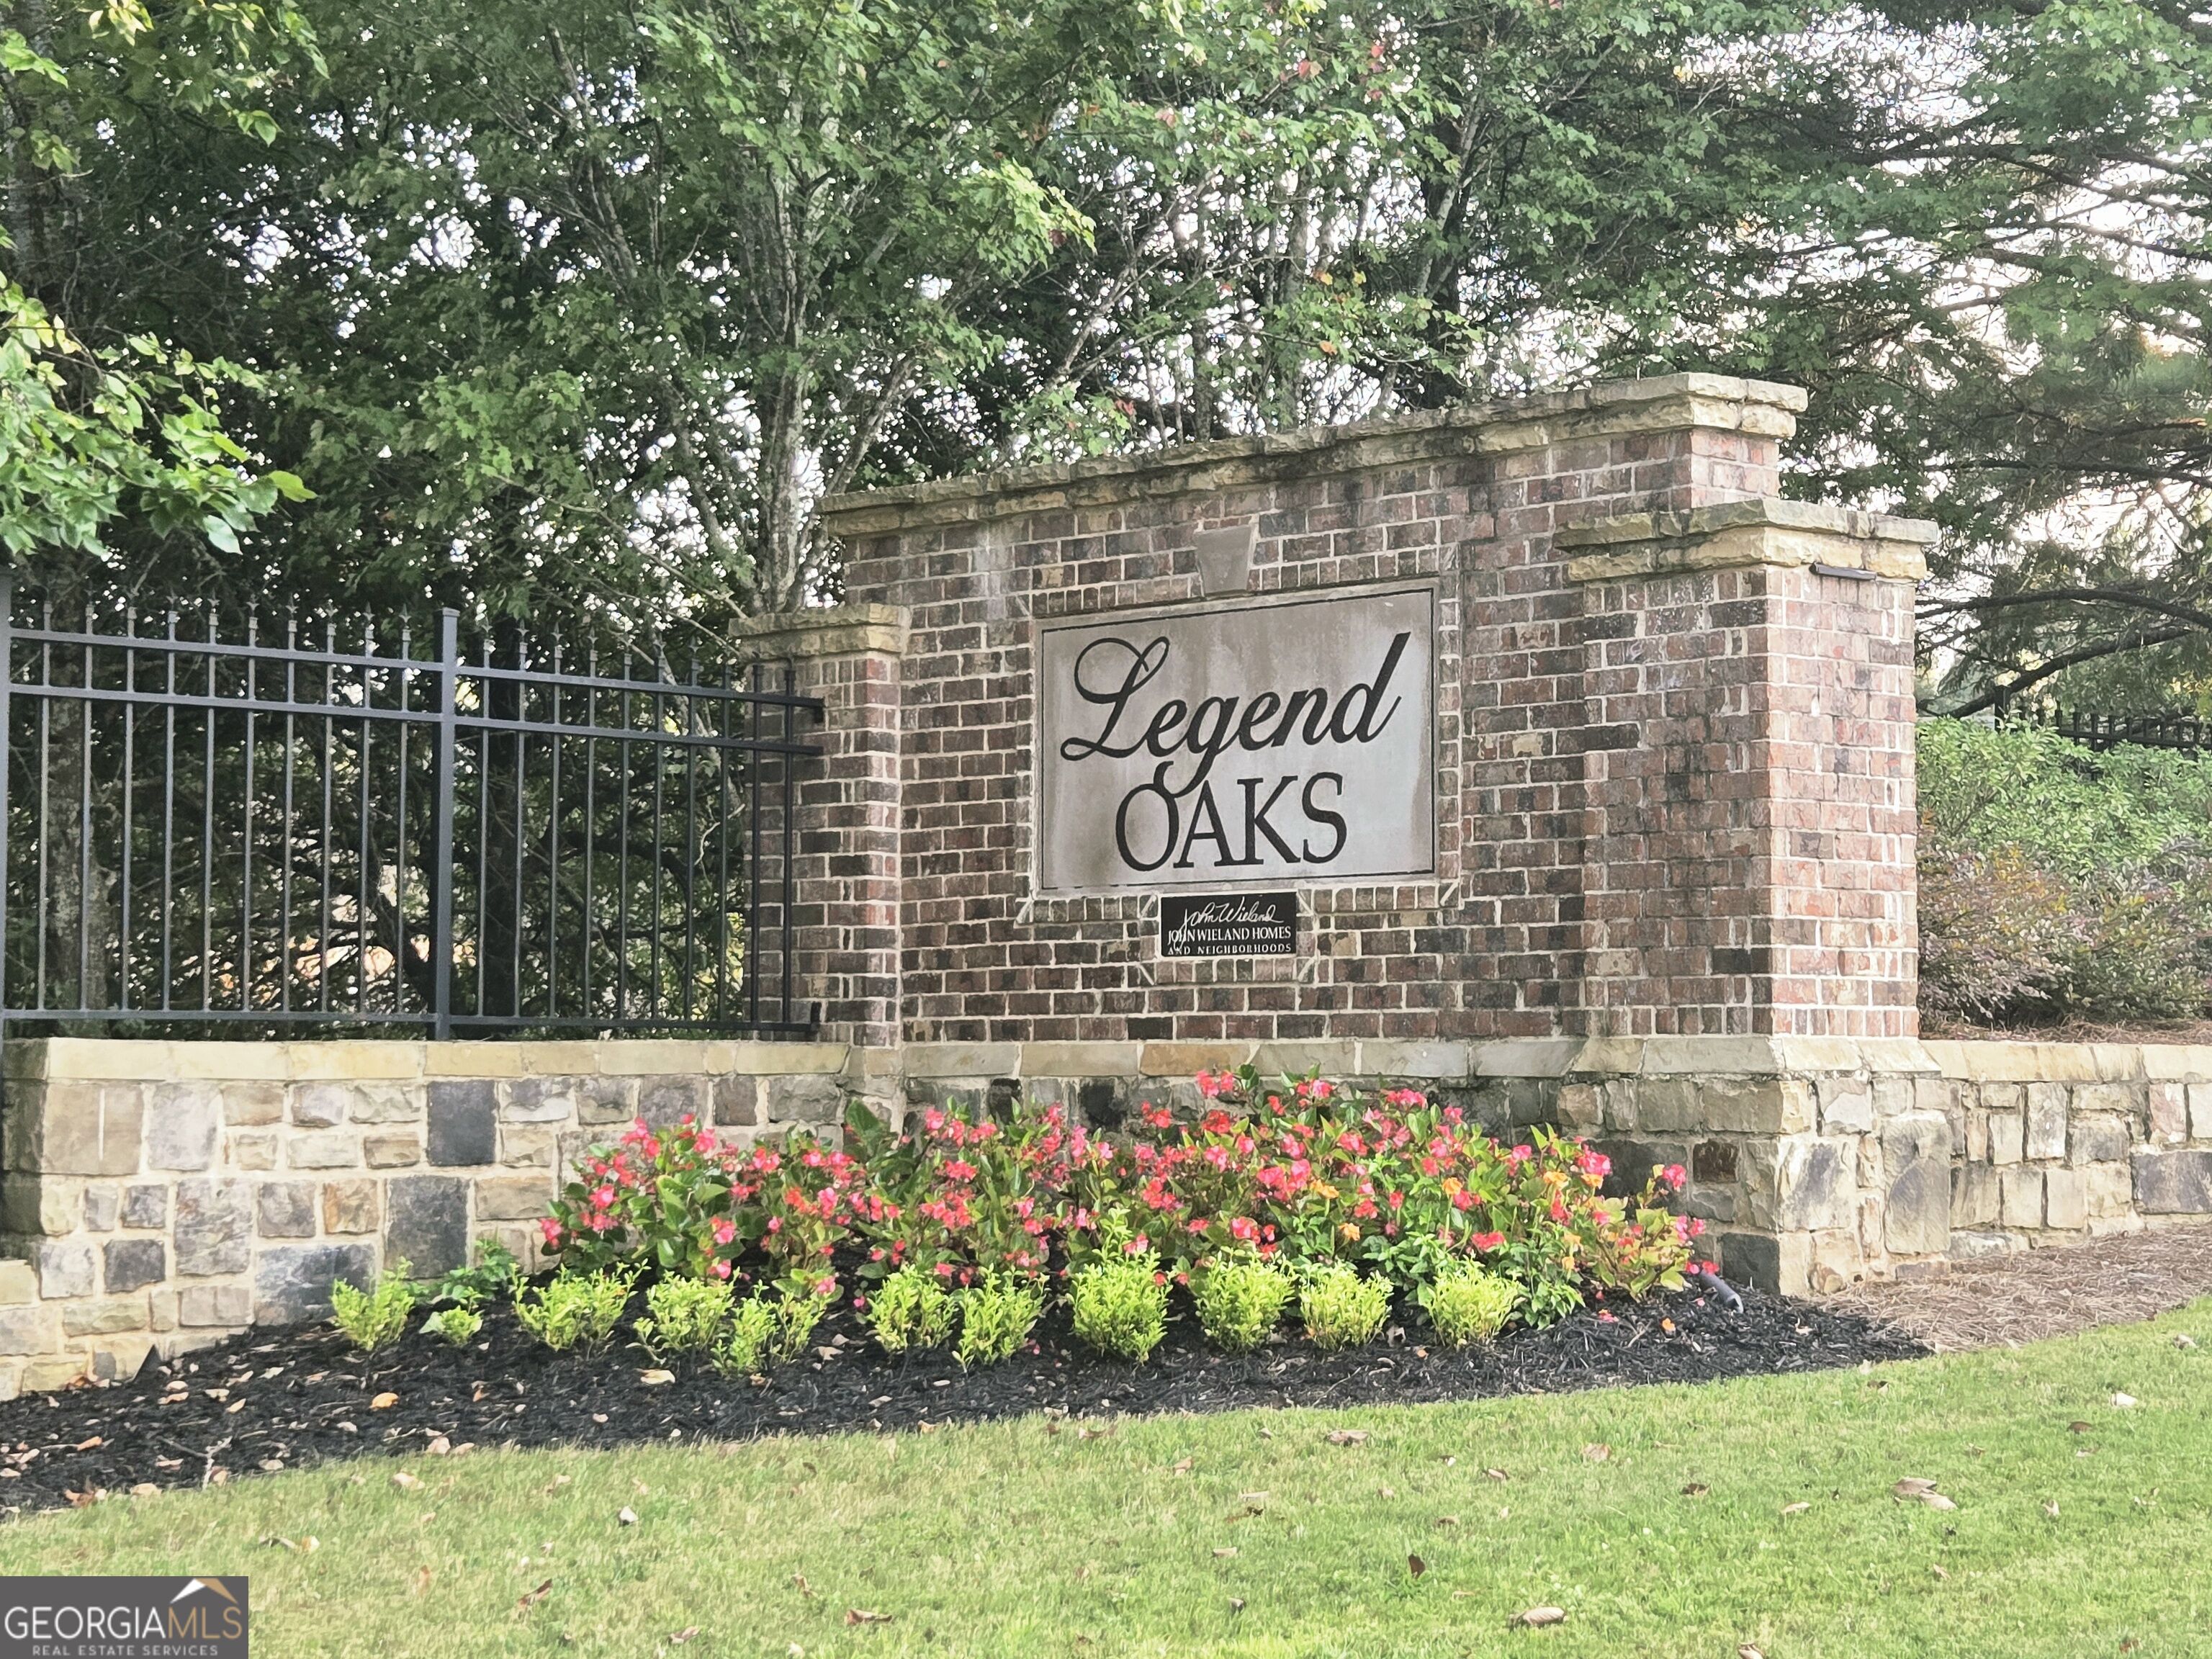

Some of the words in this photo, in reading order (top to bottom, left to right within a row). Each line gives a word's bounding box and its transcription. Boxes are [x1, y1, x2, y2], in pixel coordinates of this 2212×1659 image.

[1060, 631, 1411, 799] Legend
[1115, 771, 1348, 872] OAKS
[1167, 928, 1196, 945] JOHN
[1197, 927, 1250, 941] WIELAND
[1252, 926, 1291, 940] HOMES
[1167, 946, 1191, 955] AND
[1197, 943, 1292, 955] NEIGHBORHOODS
